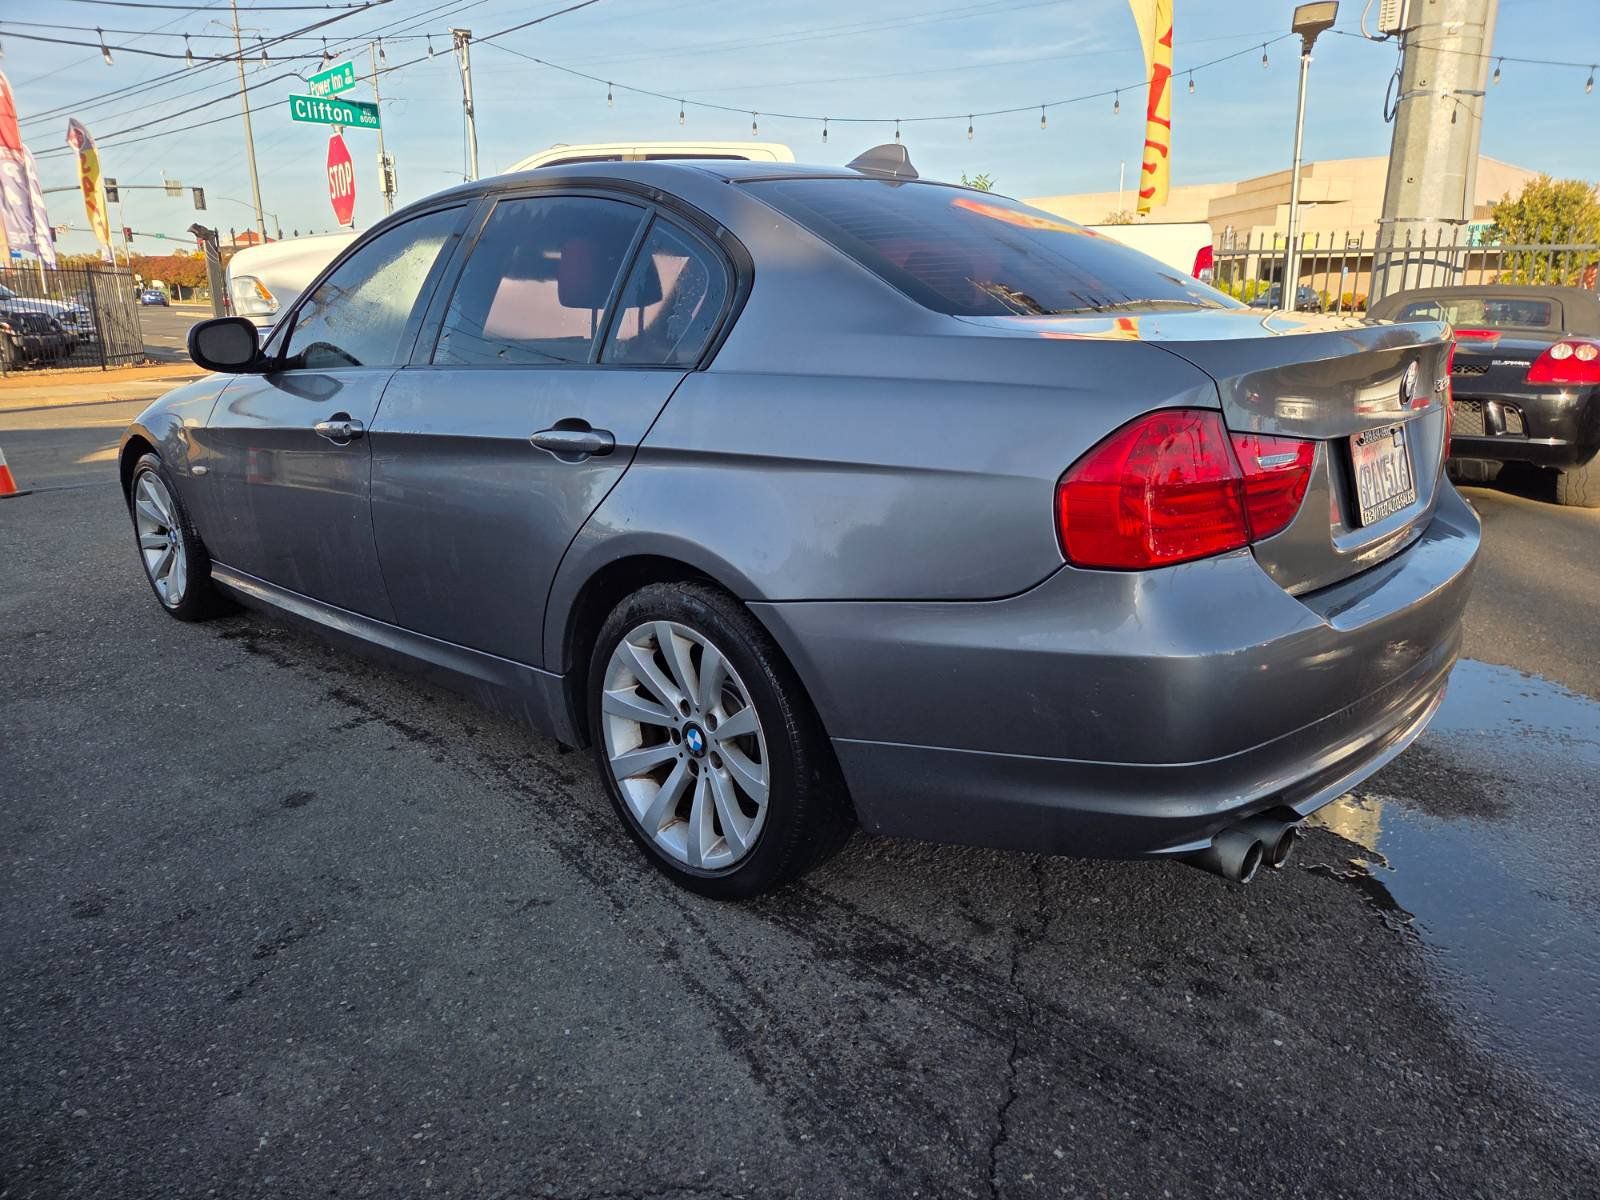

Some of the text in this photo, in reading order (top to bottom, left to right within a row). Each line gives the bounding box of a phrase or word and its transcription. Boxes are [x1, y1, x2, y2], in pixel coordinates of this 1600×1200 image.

[310, 79, 331, 97] Power
[331, 72, 344, 90] Inn
[295, 100, 353, 122] Clifton
[329, 161, 352, 200] STOP
